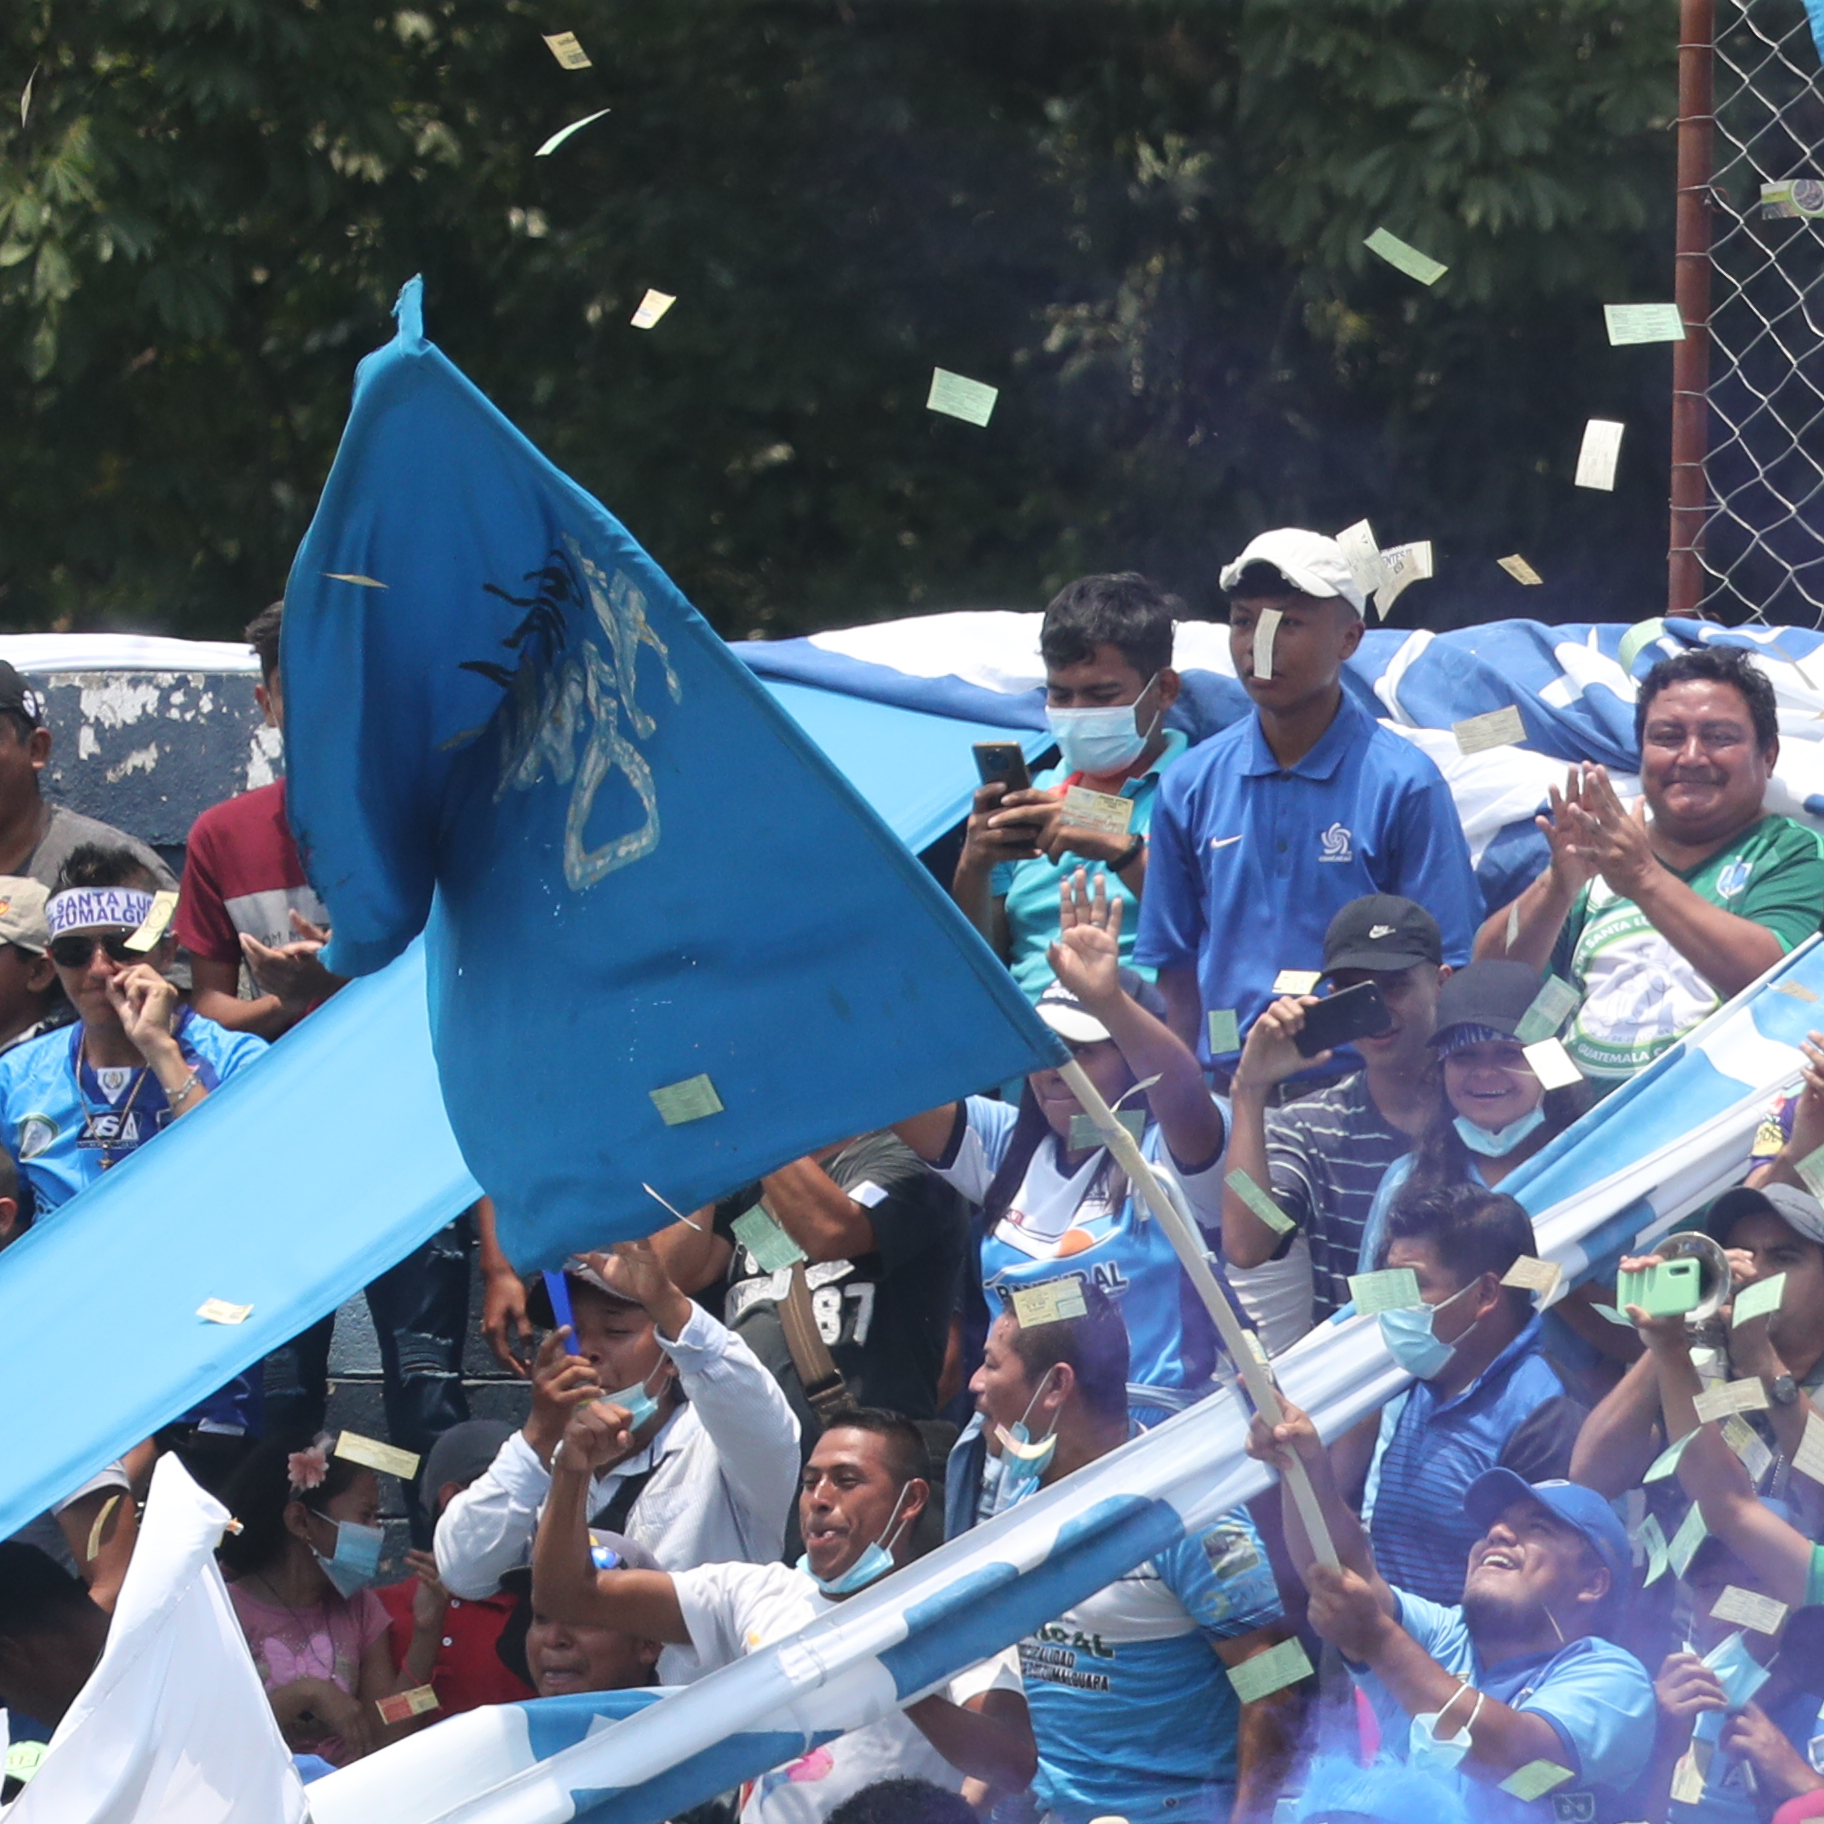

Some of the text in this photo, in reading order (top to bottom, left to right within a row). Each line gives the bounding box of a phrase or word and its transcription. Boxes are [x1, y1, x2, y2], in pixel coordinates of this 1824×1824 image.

[57, 890, 119, 912] SANTA
[1585, 922, 1628, 948] SANTA
[1577, 1045, 1650, 1064] GUATEMALA
